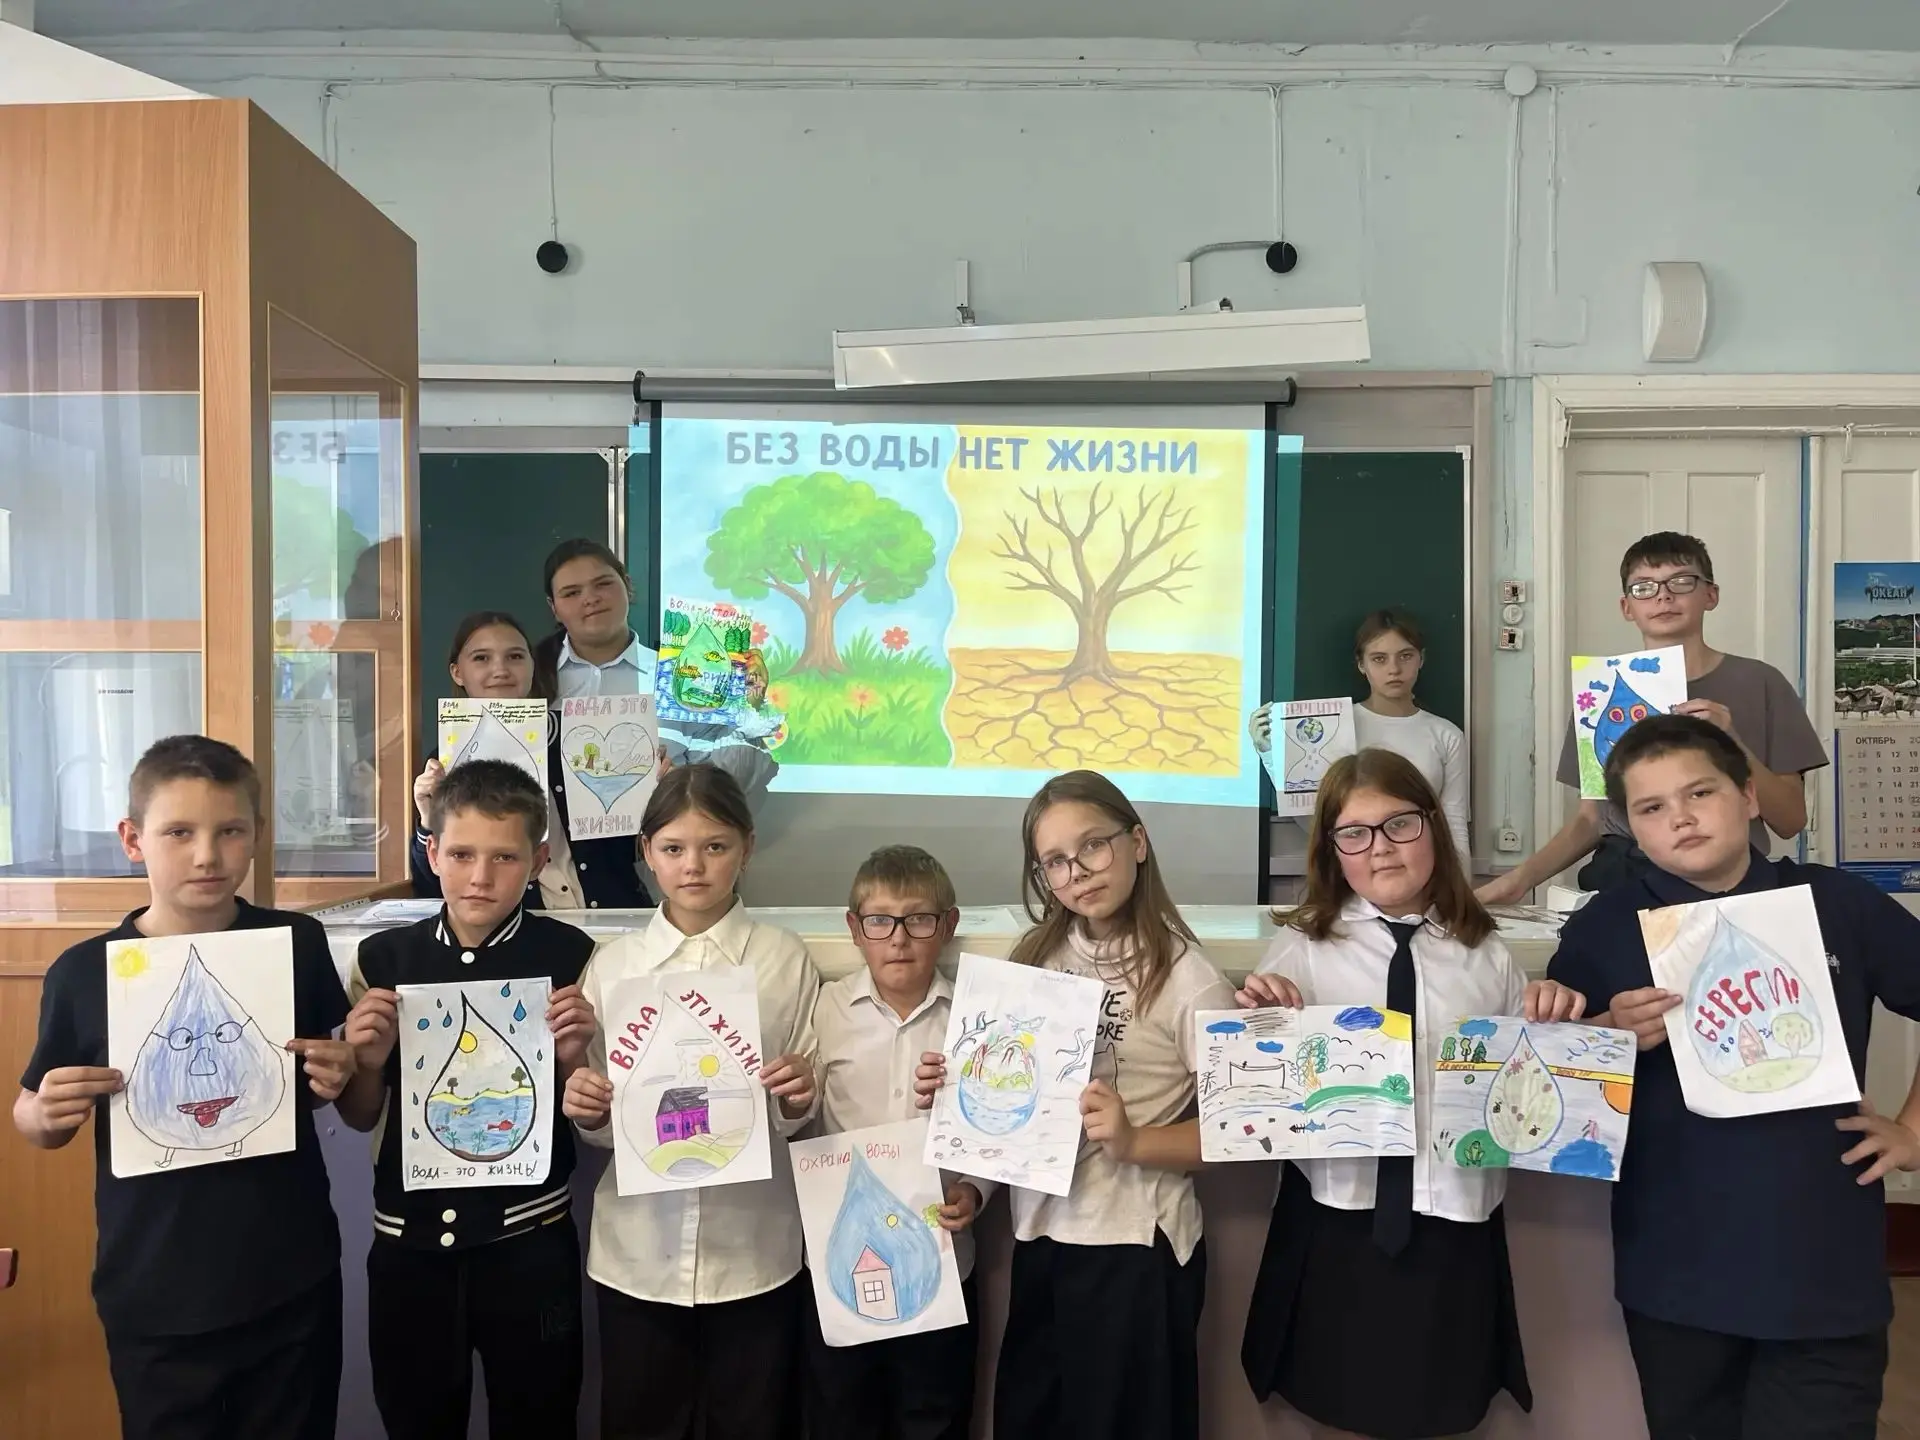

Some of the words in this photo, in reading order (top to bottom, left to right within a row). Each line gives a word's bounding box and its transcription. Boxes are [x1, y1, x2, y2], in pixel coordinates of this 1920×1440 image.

[727, 432, 799, 465] БЕЗ
[820, 433, 939, 471] ВОДЫ
[959, 436, 1029, 470] НЕТ
[1046, 438, 1198, 474] ЖИЗНИ
[564, 698, 611, 717] ВОДА
[620, 698, 647, 715] ЭТО
[1855, 737, 1896, 745] ОКТЯБРЬ
[574, 815, 634, 836] ЖИЗНЬ
[609, 1006, 658, 1070] ВОДА
[680, 989, 712, 1017] ЭТО
[709, 1014, 761, 1076] ЖИЗНЬ
